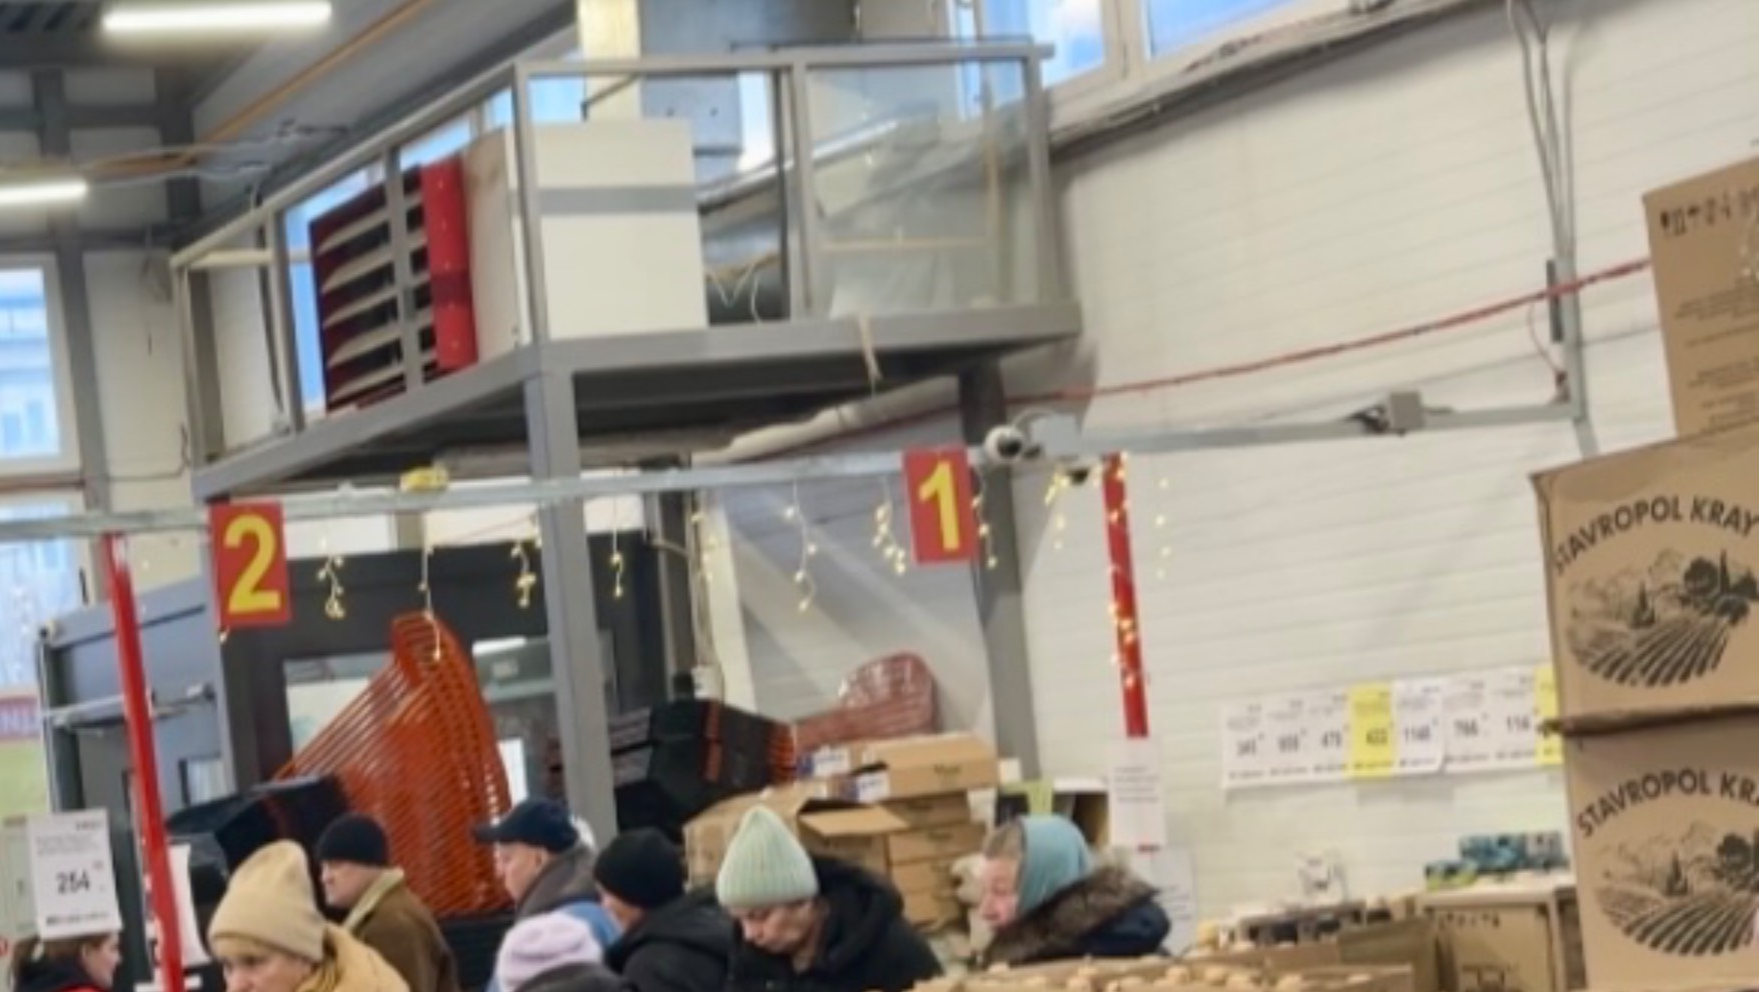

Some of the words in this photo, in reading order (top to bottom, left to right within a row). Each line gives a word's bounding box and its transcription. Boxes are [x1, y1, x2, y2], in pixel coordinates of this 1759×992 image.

[922, 464, 960, 550] 1
[1554, 496, 1683, 576] STAVROPOL
[1690, 496, 1759, 538] KRAY
[227, 516, 281, 613] 2
[1576, 766, 1712, 838] STAVROPOL
[1720, 771, 1759, 807] KR
